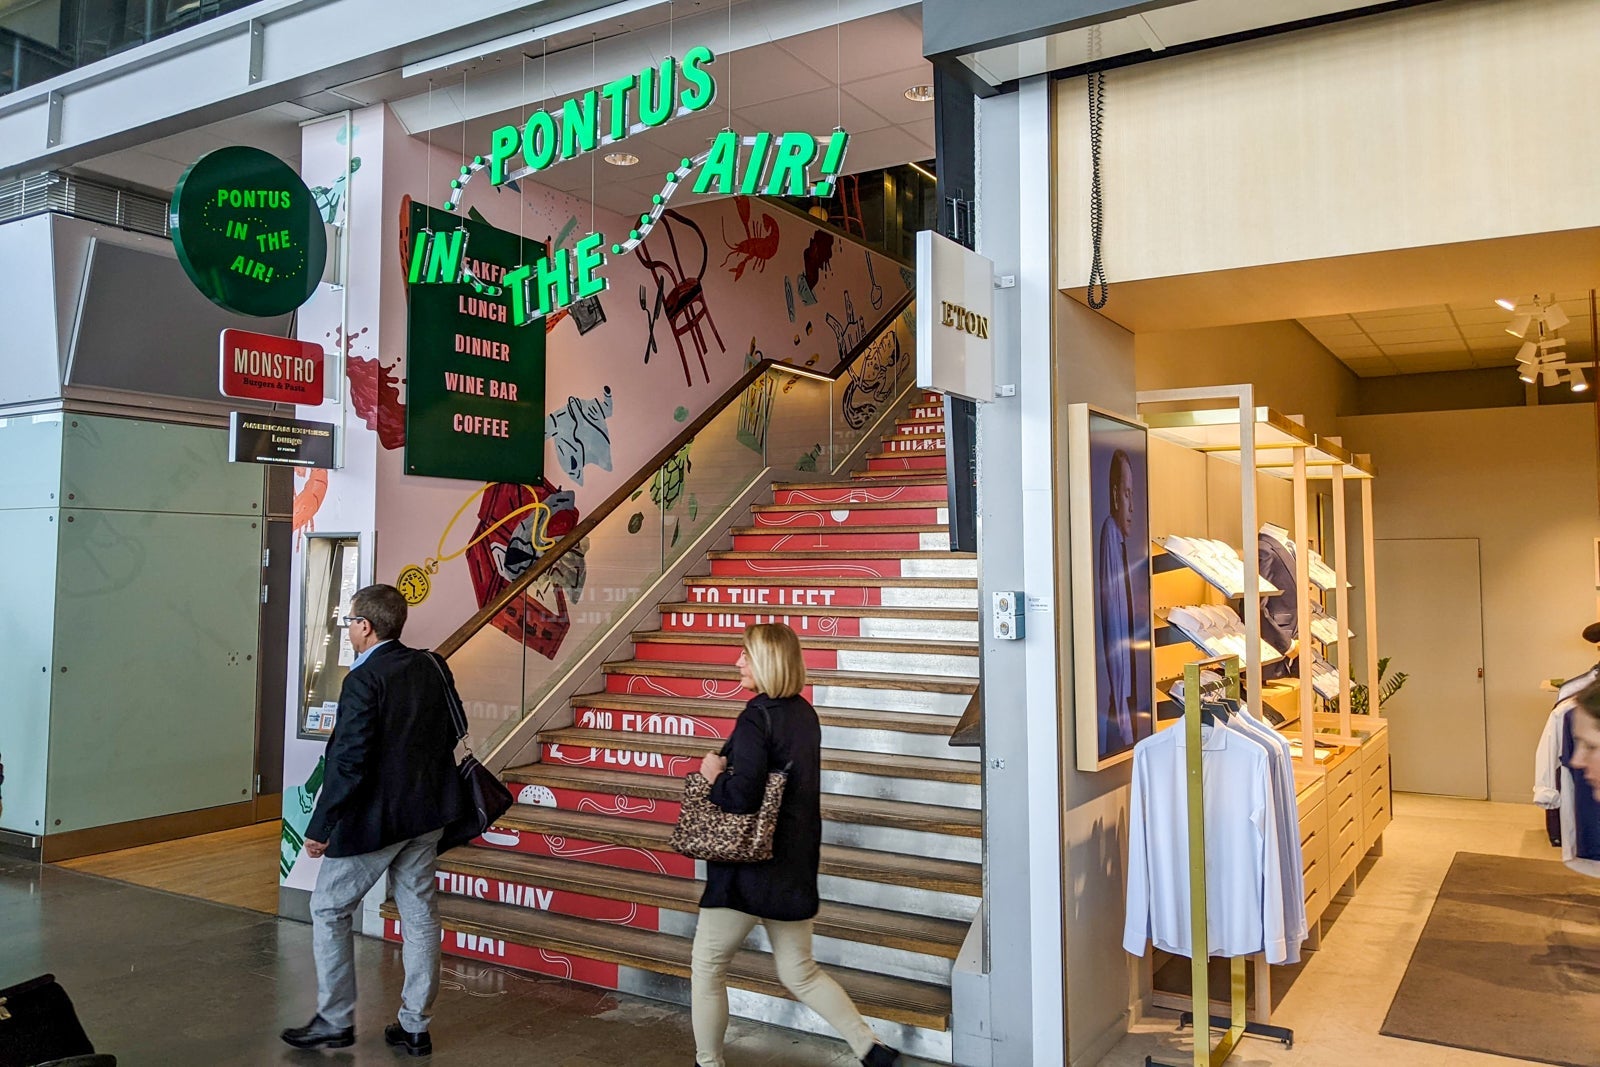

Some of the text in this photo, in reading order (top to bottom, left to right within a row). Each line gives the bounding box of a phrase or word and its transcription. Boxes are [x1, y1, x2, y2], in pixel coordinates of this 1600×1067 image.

[491, 46, 715, 186] PONTUS
[692, 132, 849, 197] AIR!
[217, 189, 291, 209] PONTUS
[226, 220, 290, 253] IN THE
[230, 255, 274, 283] AIR!
[408, 230, 607, 326] IN THE
[458, 295, 507, 323] LUNCH
[941, 301, 990, 339] ETON
[455, 333, 510, 362] DINNER
[234, 347, 314, 383] MONSTRO
[243, 377, 275, 388] Burgers
[285, 383, 305, 392] Pasta
[444, 371, 518, 401] WINE BAR
[271, 434, 303, 446] Lounge
[453, 413, 509, 438] COFFEE
